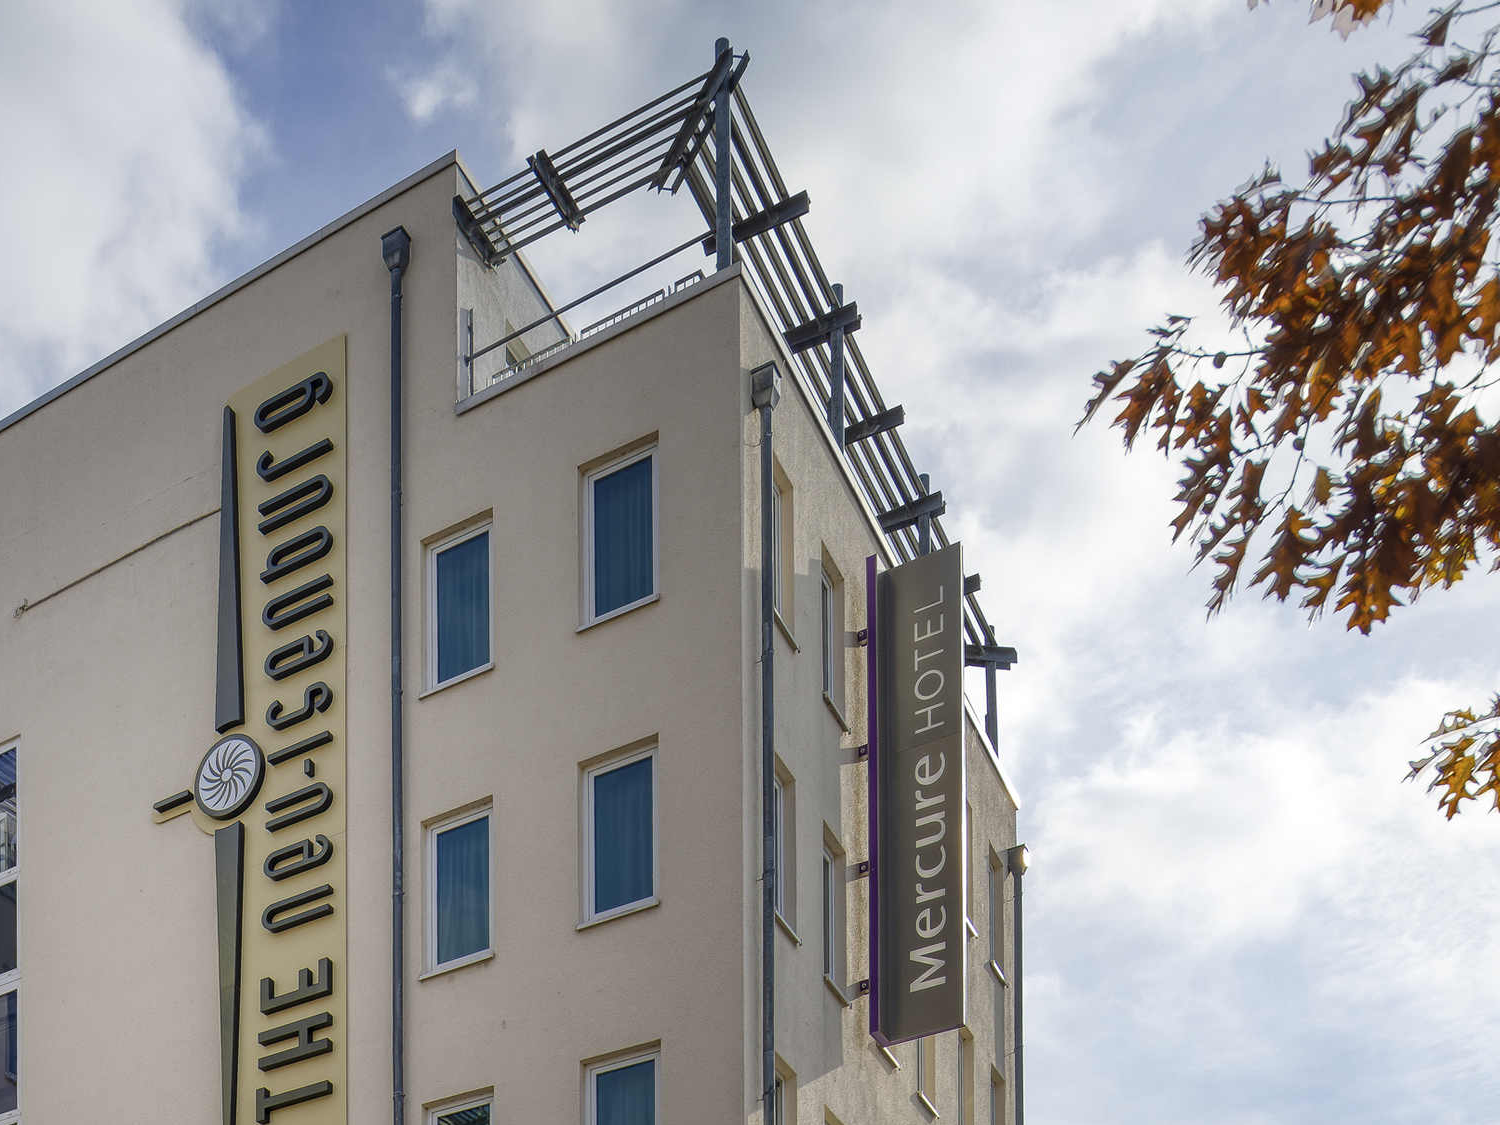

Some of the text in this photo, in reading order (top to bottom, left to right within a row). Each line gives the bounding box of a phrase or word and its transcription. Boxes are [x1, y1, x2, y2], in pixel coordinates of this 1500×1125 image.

[253, 371, 334, 1125] THE neu-Isenburg
[909, 584, 947, 994] Mercure HOTEL
